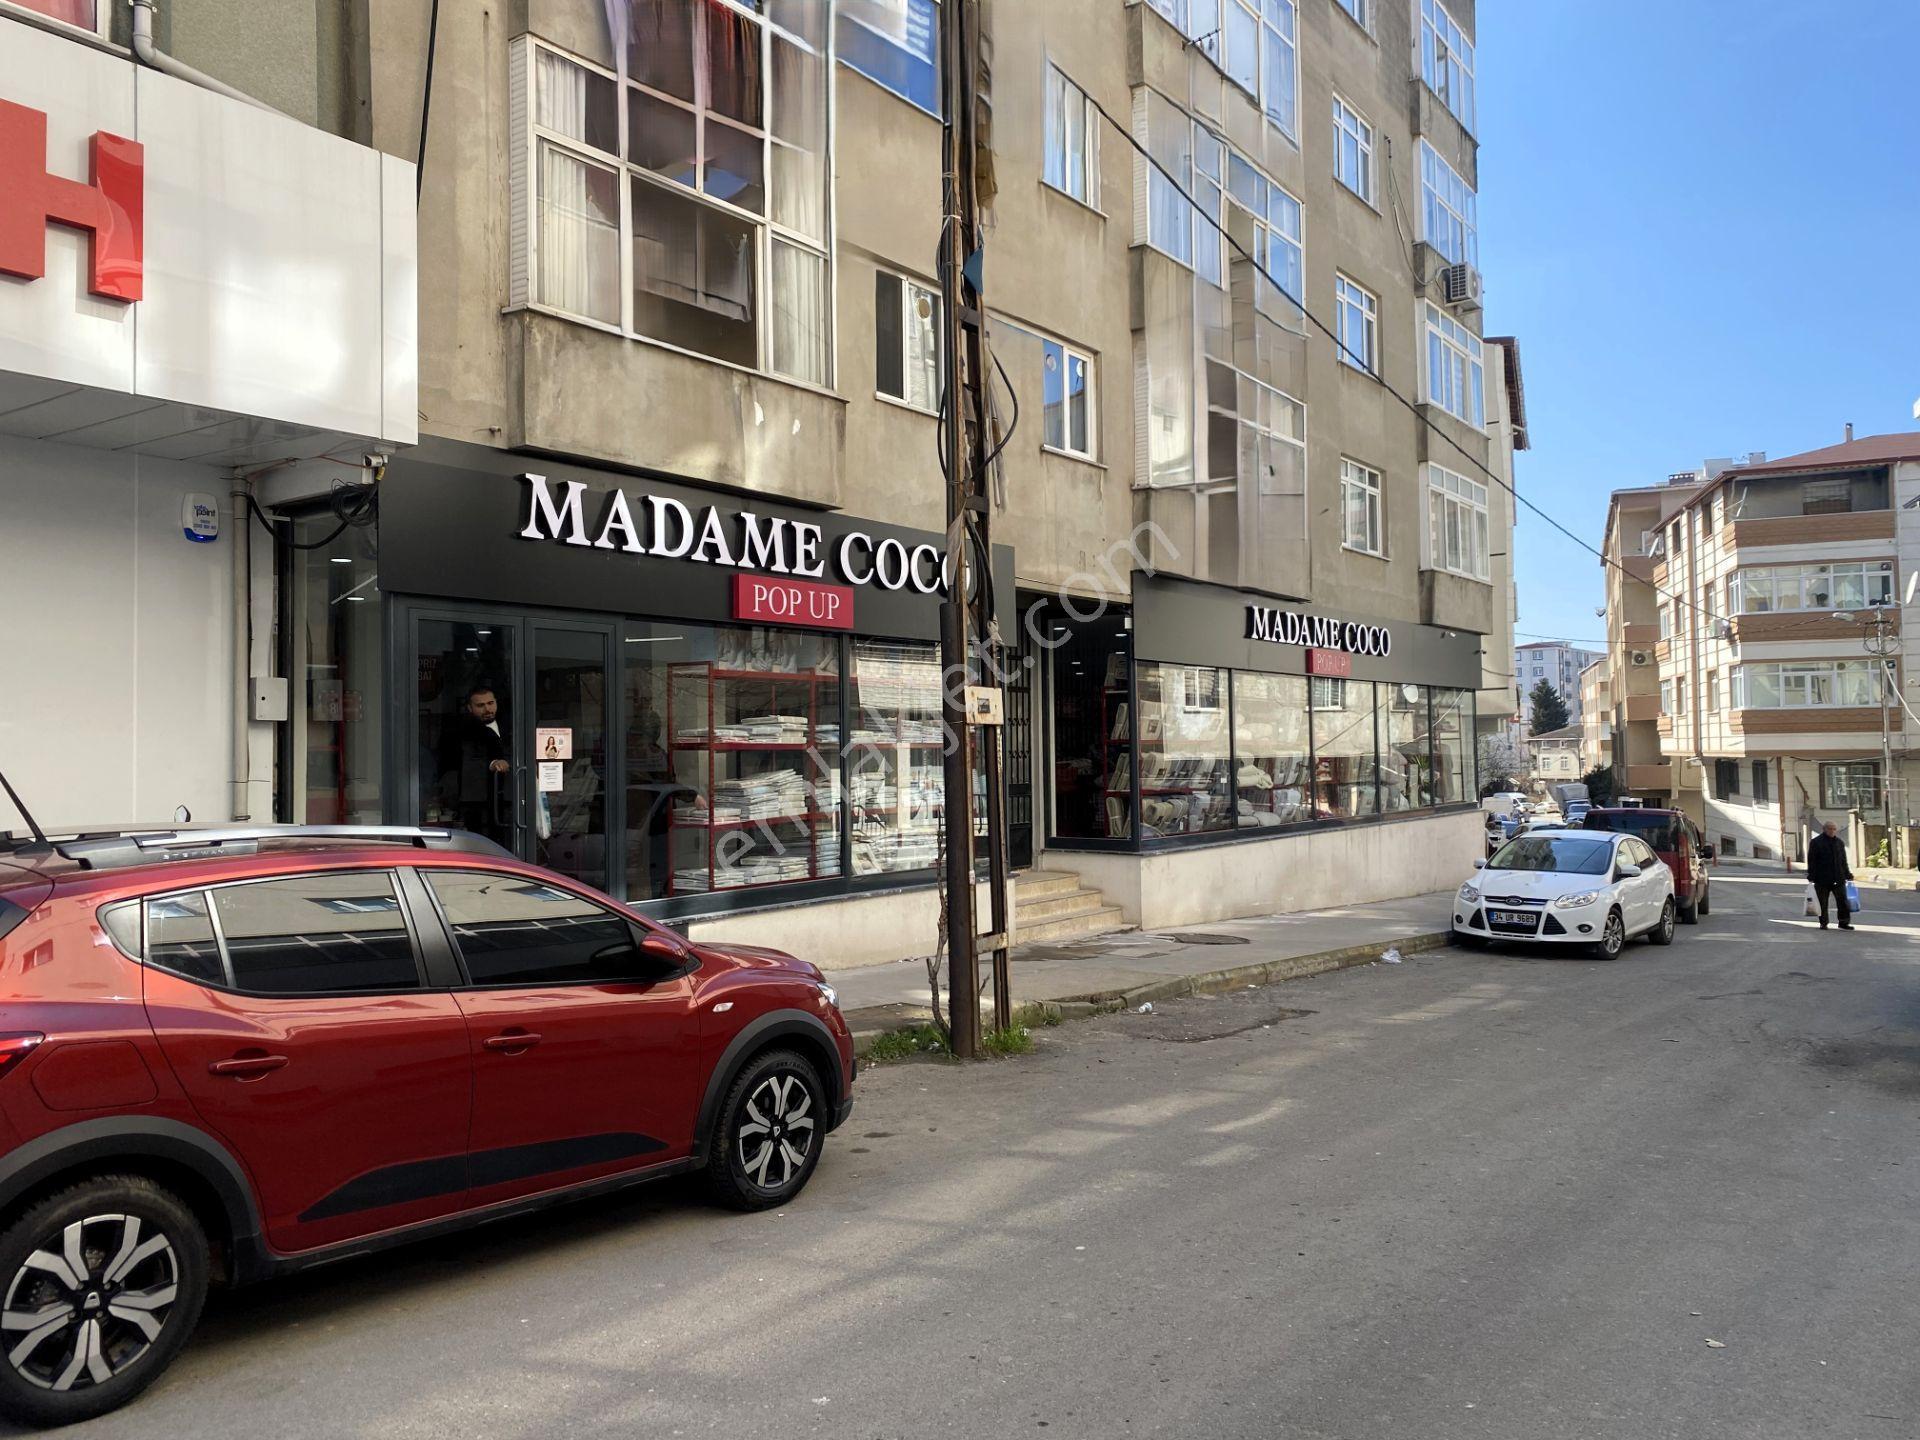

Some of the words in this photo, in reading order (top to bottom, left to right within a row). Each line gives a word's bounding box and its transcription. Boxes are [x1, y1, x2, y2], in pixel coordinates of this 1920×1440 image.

[520, 472, 825, 578] MADAME
[752, 584, 802, 617] POP
[809, 589, 840, 620] UP
[1251, 605, 1341, 650] MADAME
[1346, 622, 1391, 656] COCO
[1317, 653, 1333, 671] POP
